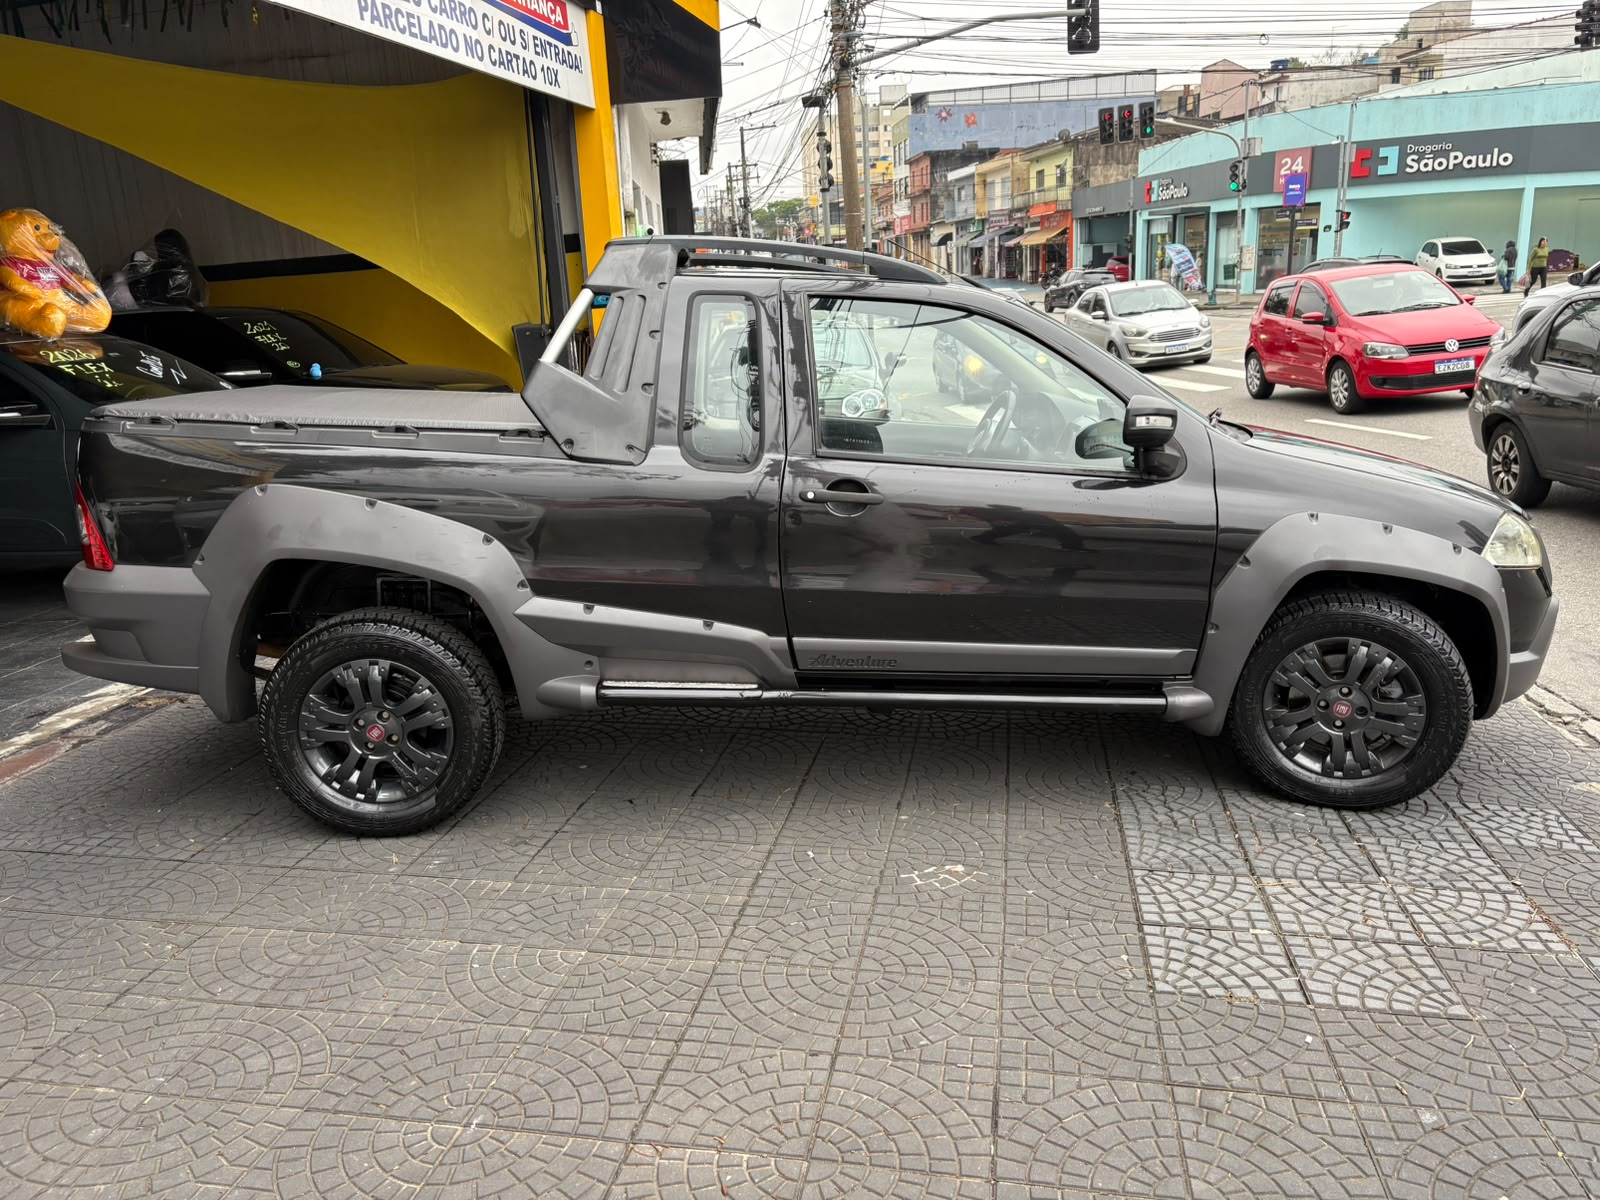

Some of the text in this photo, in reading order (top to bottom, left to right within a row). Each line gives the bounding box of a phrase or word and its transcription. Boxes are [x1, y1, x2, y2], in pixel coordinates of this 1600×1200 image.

[357, 0, 460, 53] PARCELADO
[463, 33, 484, 62] NO
[541, 64, 561, 88] 10X
[428, 0, 583, 74] CARRO C/ OU S/ ENTRADA!
[1407, 142, 1452, 153] Drogaria
[1280, 155, 1304, 175] 24
[1405, 147, 1513, 173] SãoPaulo
[57, 362, 114, 376] FLEX
[808, 653, 897, 668] Adventure
